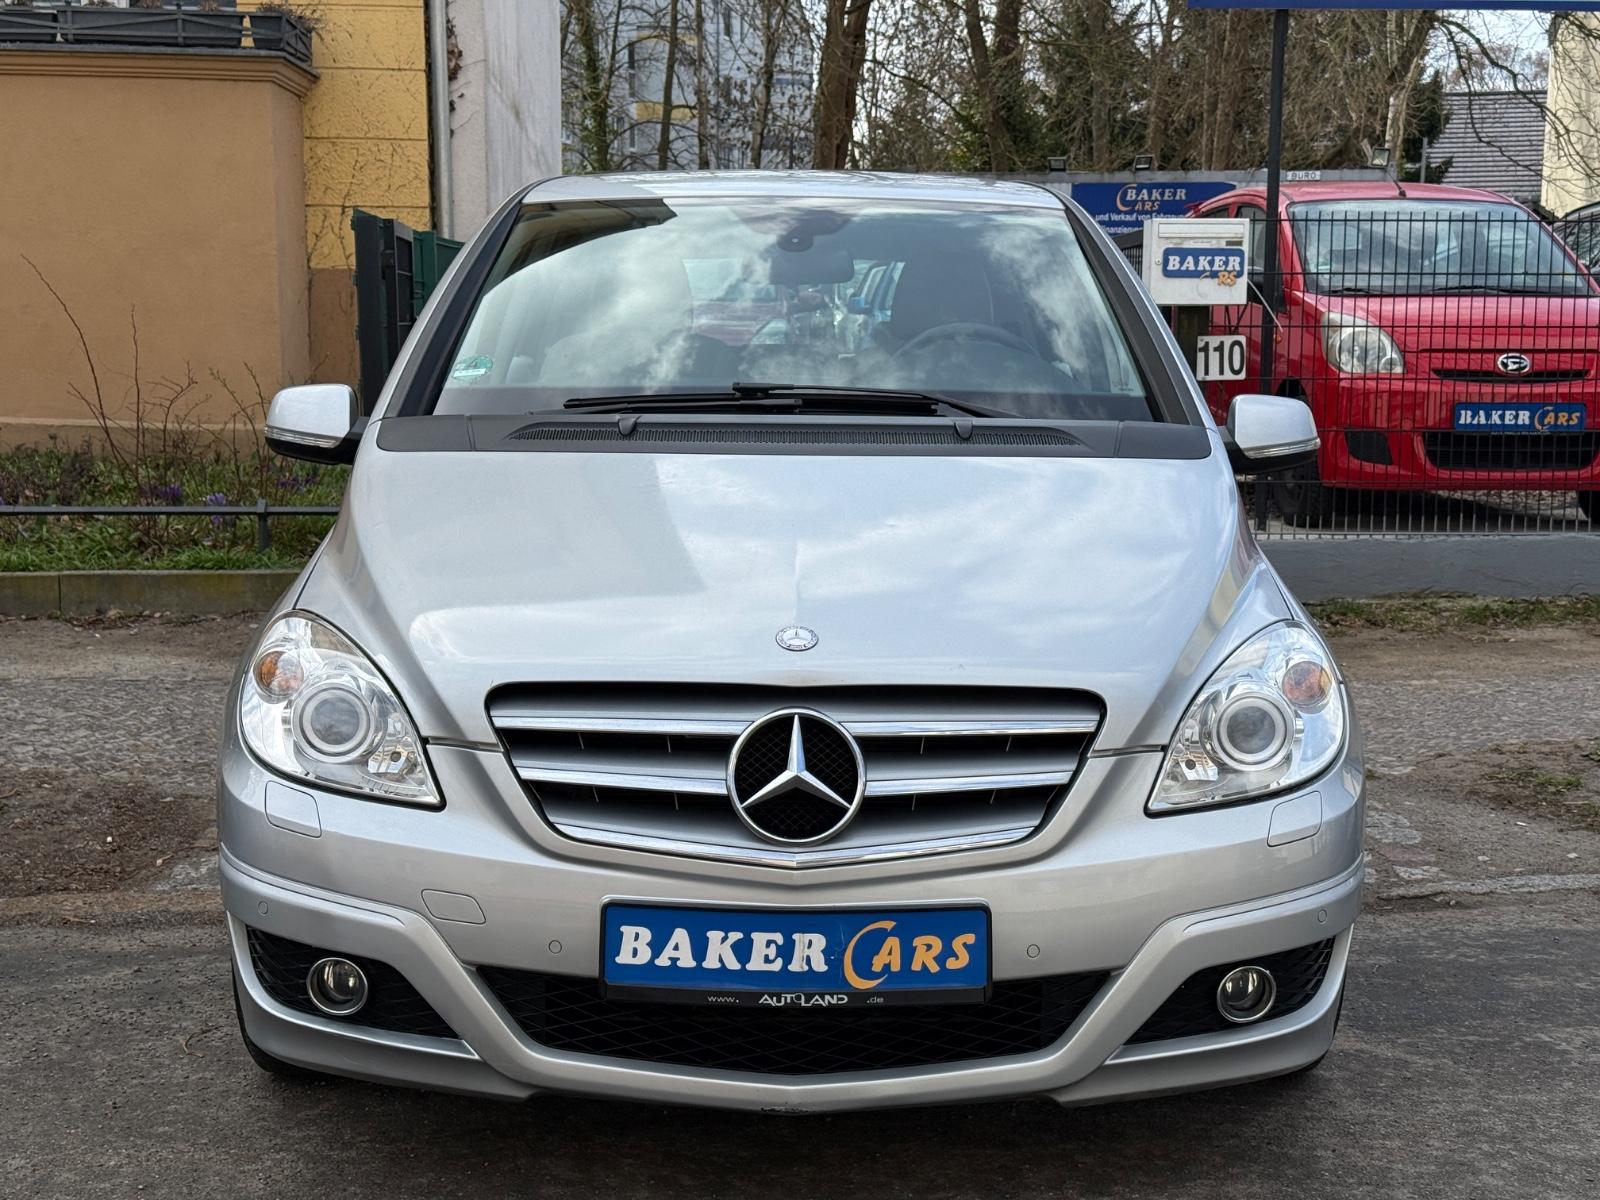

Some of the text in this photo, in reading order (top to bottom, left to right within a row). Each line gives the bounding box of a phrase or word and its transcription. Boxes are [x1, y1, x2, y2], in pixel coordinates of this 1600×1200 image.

[1125, 188, 1187, 201] BAKER
[1095, 213, 1109, 222] und
[1110, 212, 1138, 222] Verkauf
[1167, 255, 1241, 271] BAKER
[1198, 340, 1245, 376] 110
[1458, 406, 1581, 431] BAKER CARS
[615, 920, 976, 990] BAKER CARS
[758, 993, 848, 1007] AUTOLAND
